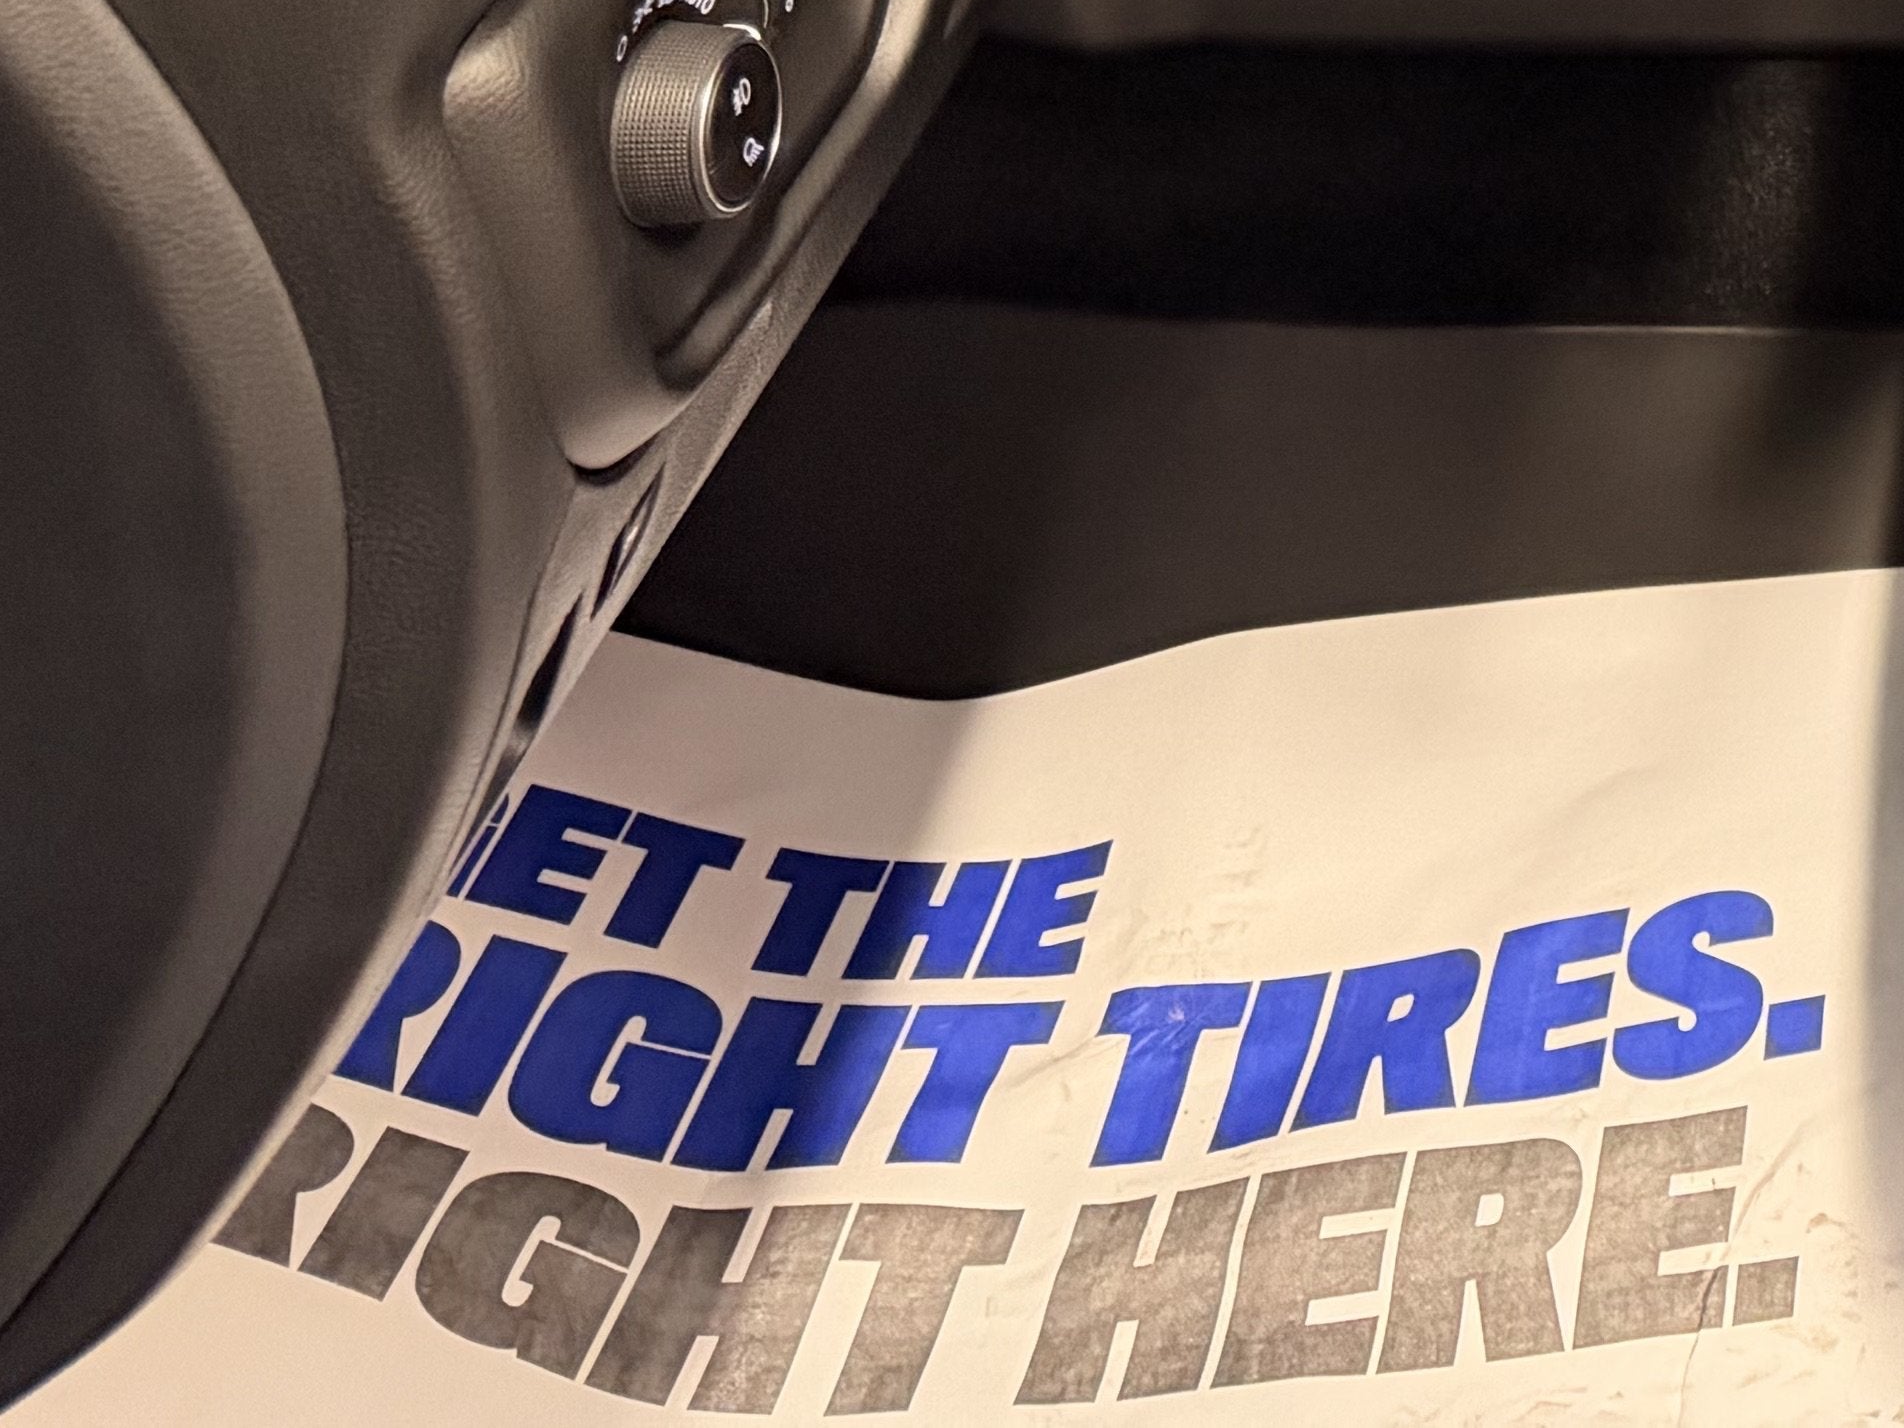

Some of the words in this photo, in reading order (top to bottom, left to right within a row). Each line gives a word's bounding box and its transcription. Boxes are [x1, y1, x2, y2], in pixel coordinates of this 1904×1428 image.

[447, 785, 745, 948] ET
[752, 840, 1113, 980] THE
[1090, 890, 1826, 1167] TIRES.
[1013, 1106, 1799, 1406] HERE.
